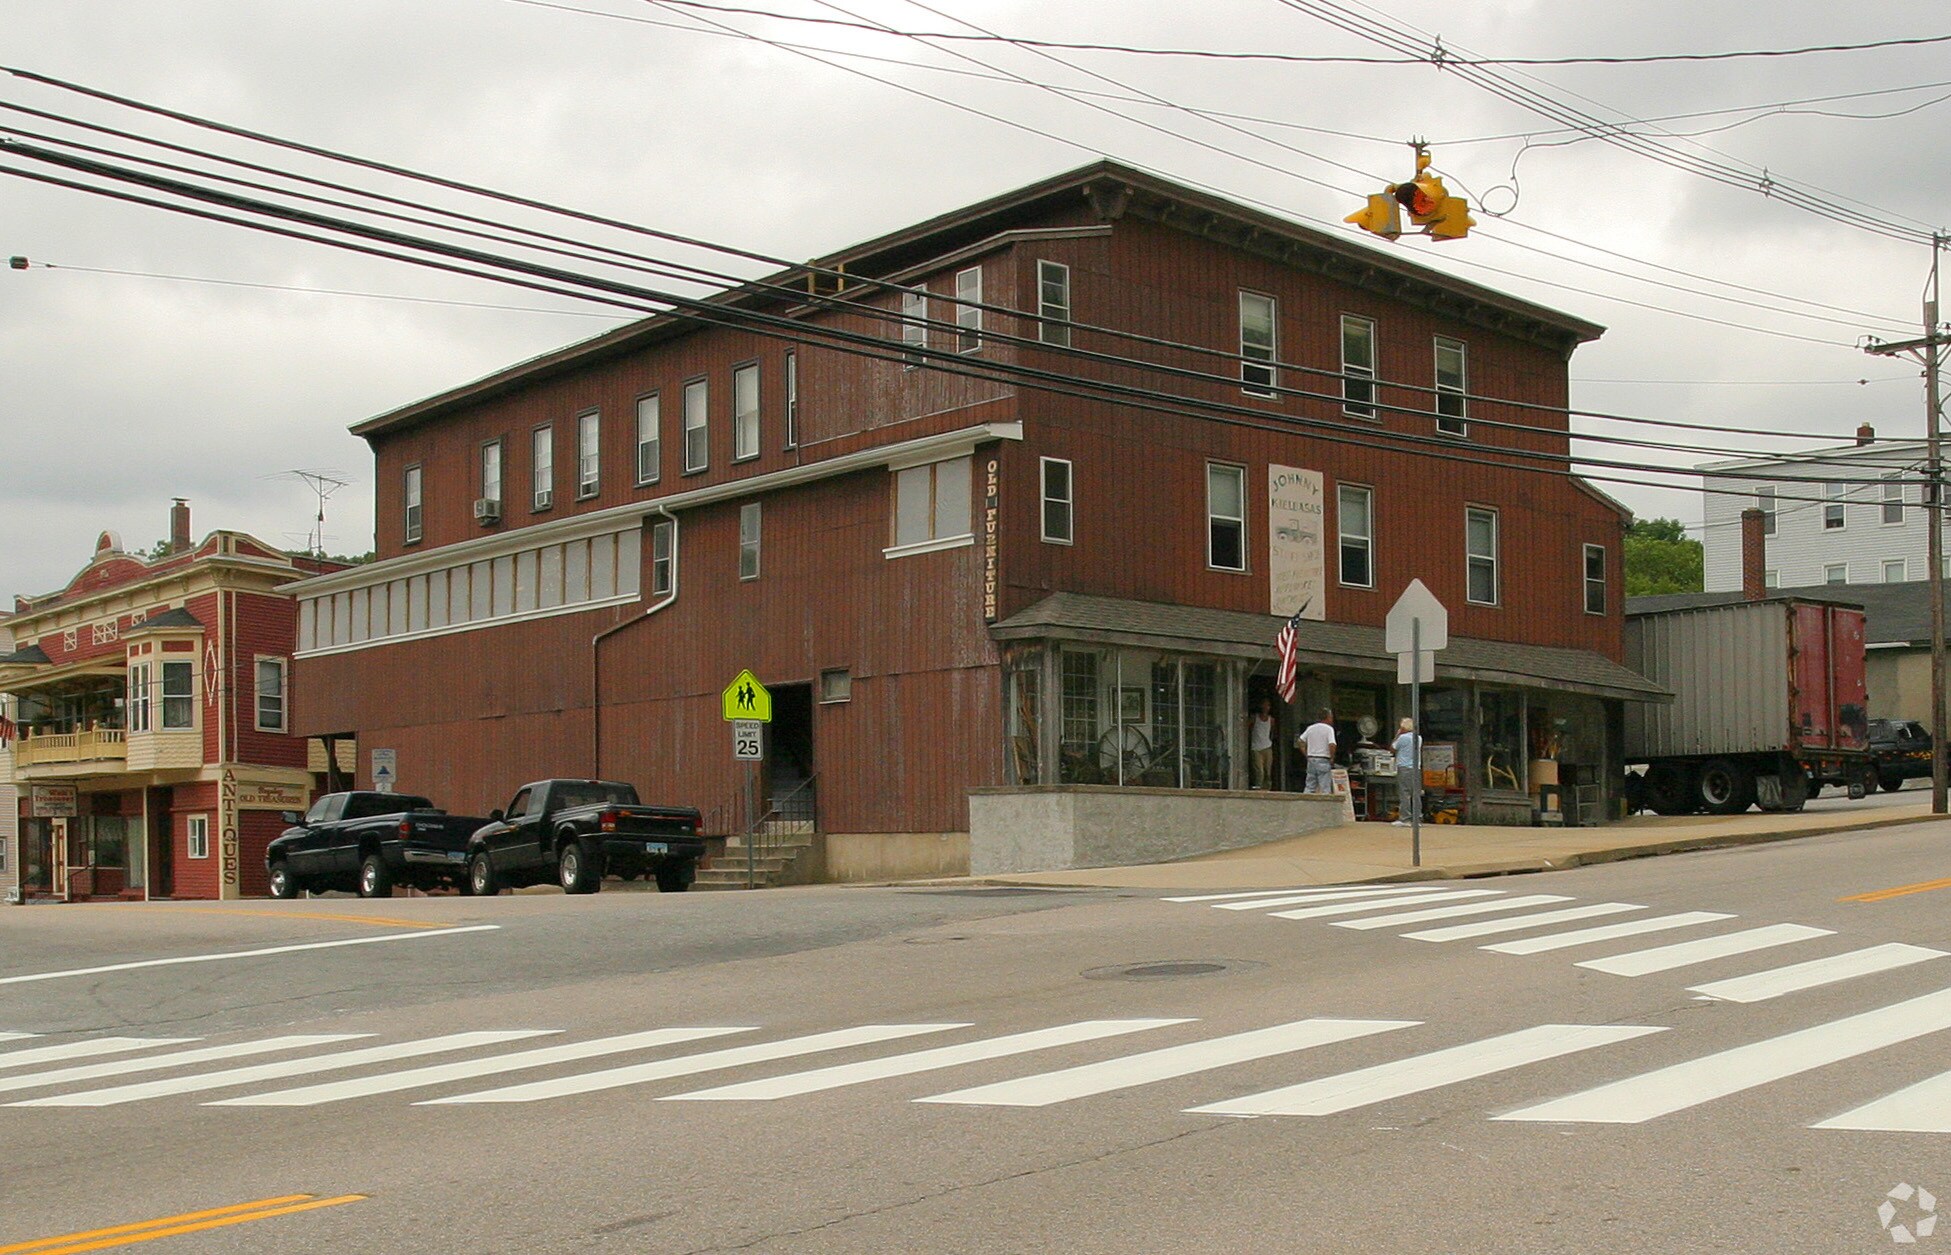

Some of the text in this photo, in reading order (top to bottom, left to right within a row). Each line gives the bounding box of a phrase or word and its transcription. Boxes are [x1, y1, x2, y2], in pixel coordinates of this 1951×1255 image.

[1273, 474, 1319, 496] JOHNNY
[985, 460, 997, 618] OLD FURNITURE
[737, 740, 759, 755] 25
[240, 795, 256, 803] OLD
[222, 769, 237, 885] ANTIQUES
